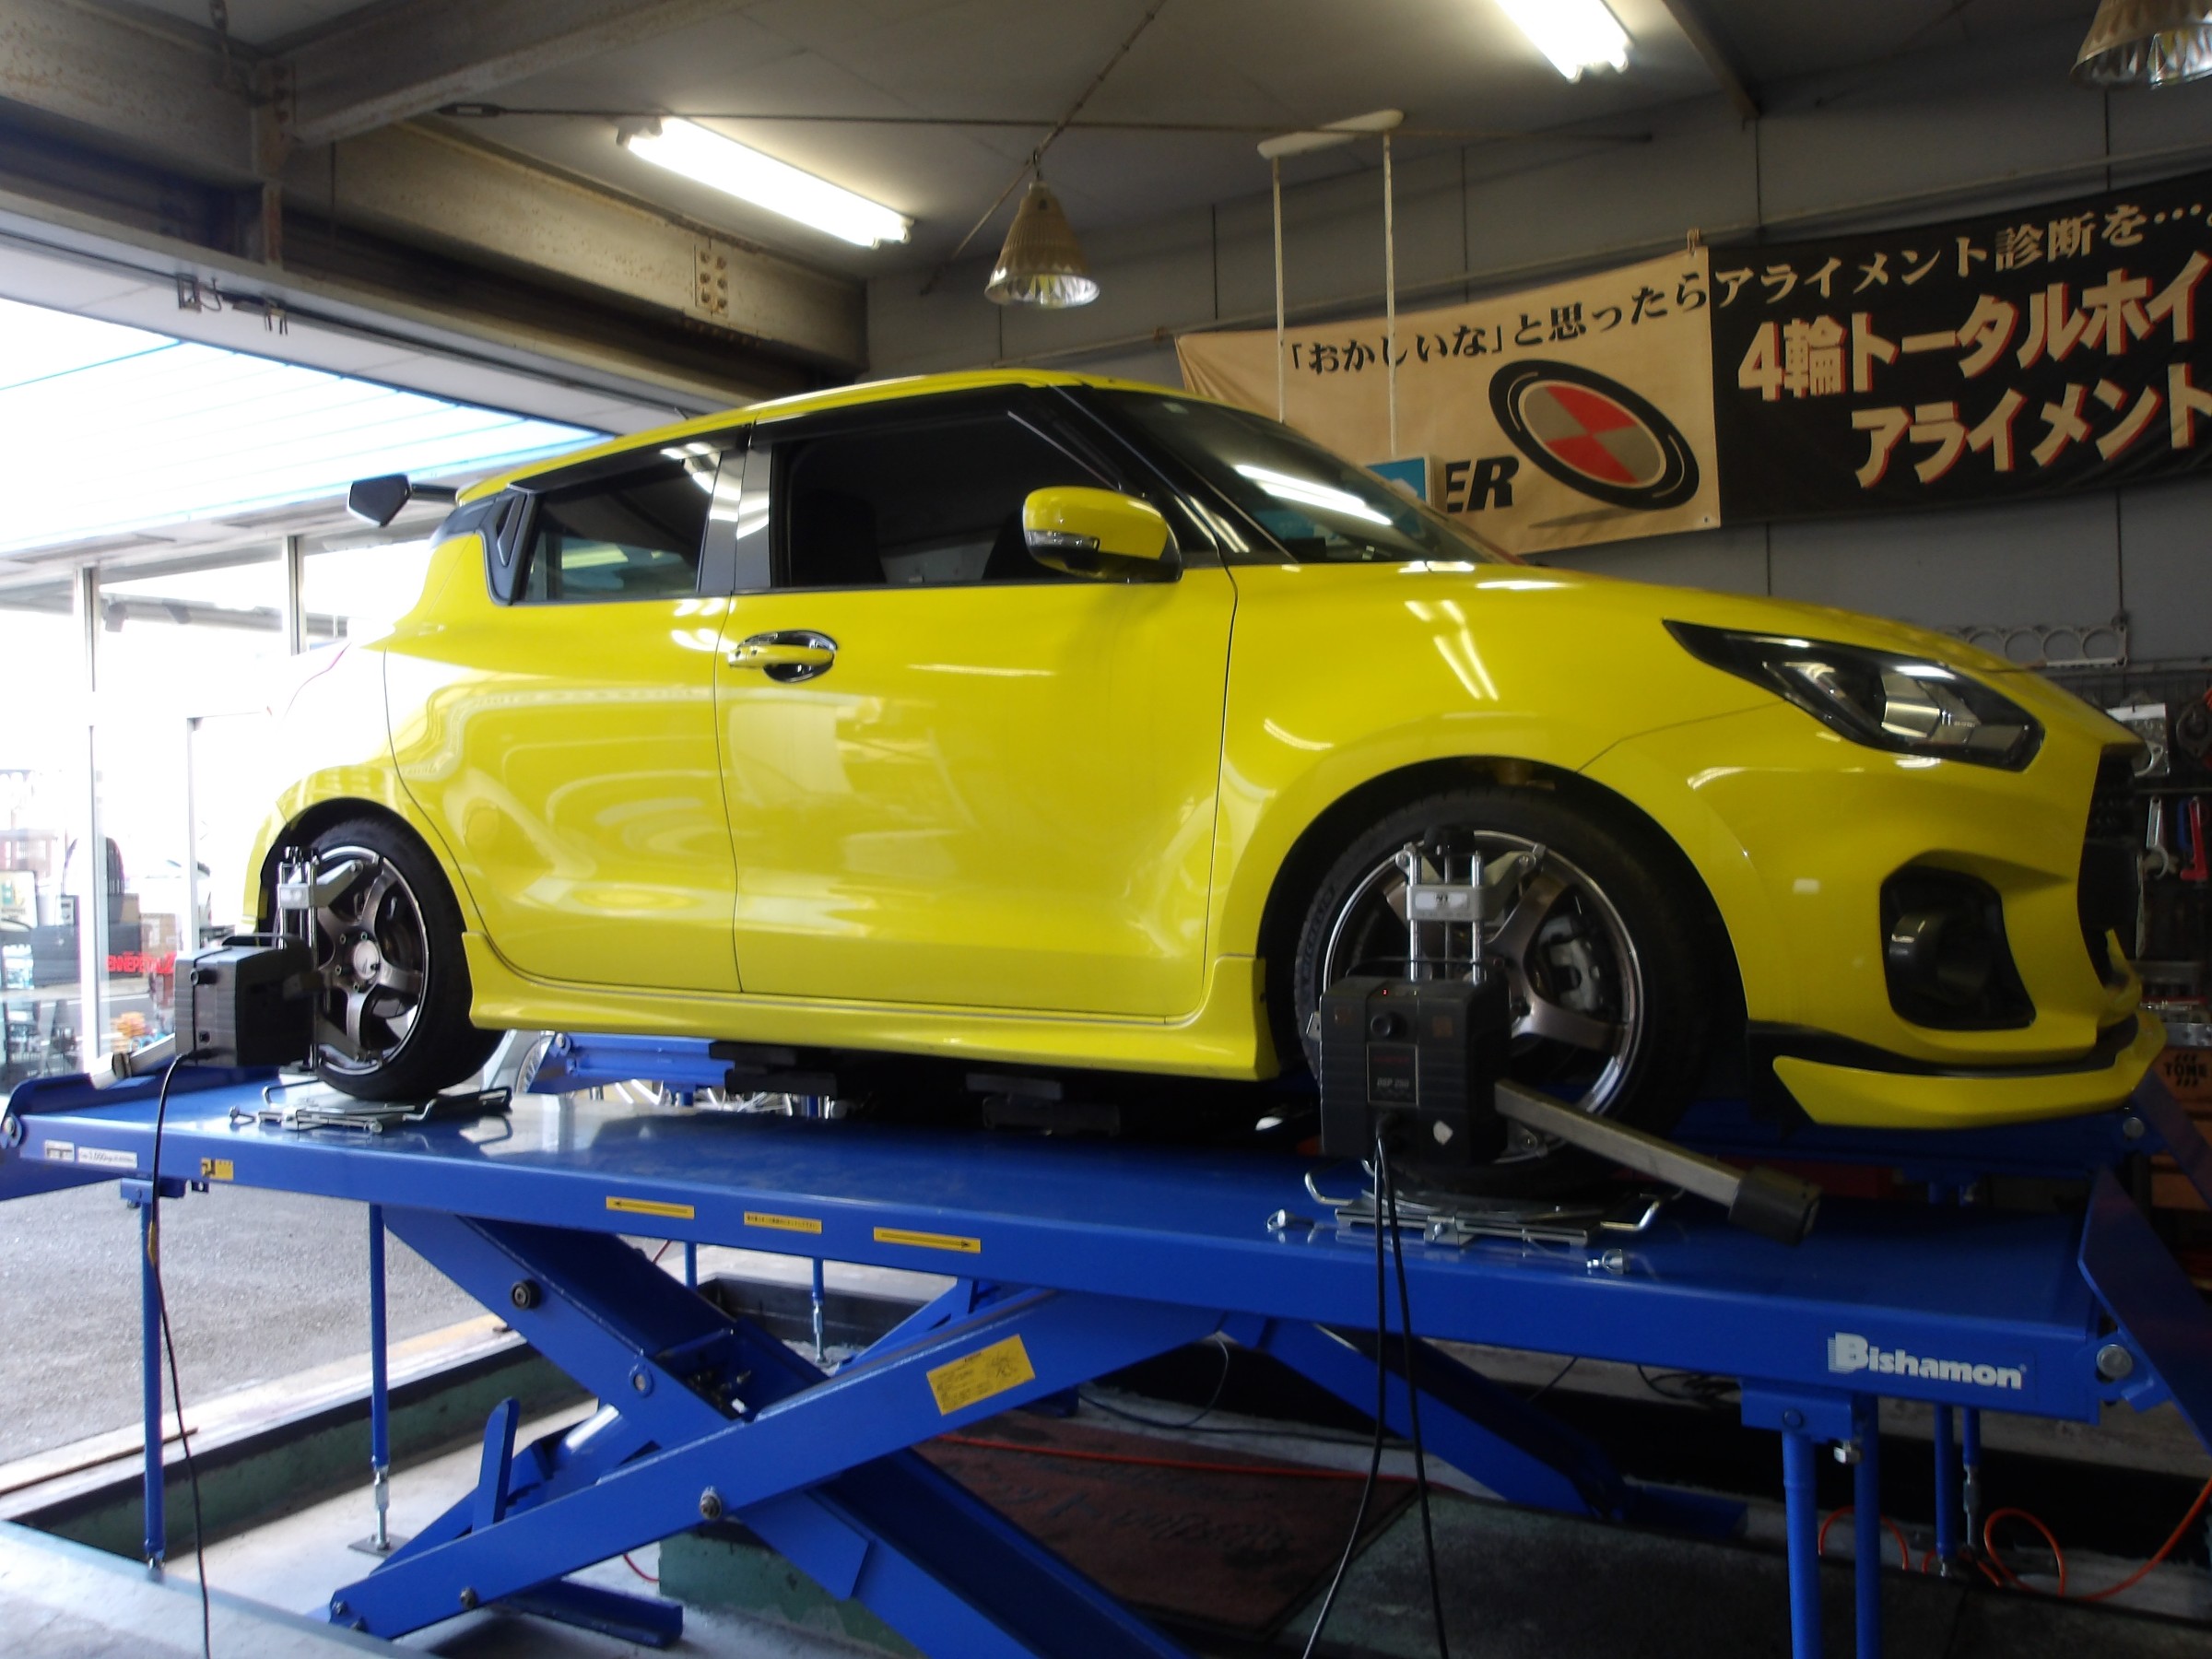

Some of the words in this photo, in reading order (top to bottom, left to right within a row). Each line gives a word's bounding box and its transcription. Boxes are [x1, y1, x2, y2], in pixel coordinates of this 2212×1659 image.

[1738, 250, 2212, 402] 4輪トータルホイ
[1851, 363, 2212, 489] アライメント
[1828, 1332, 2022, 1390] Bishamon
